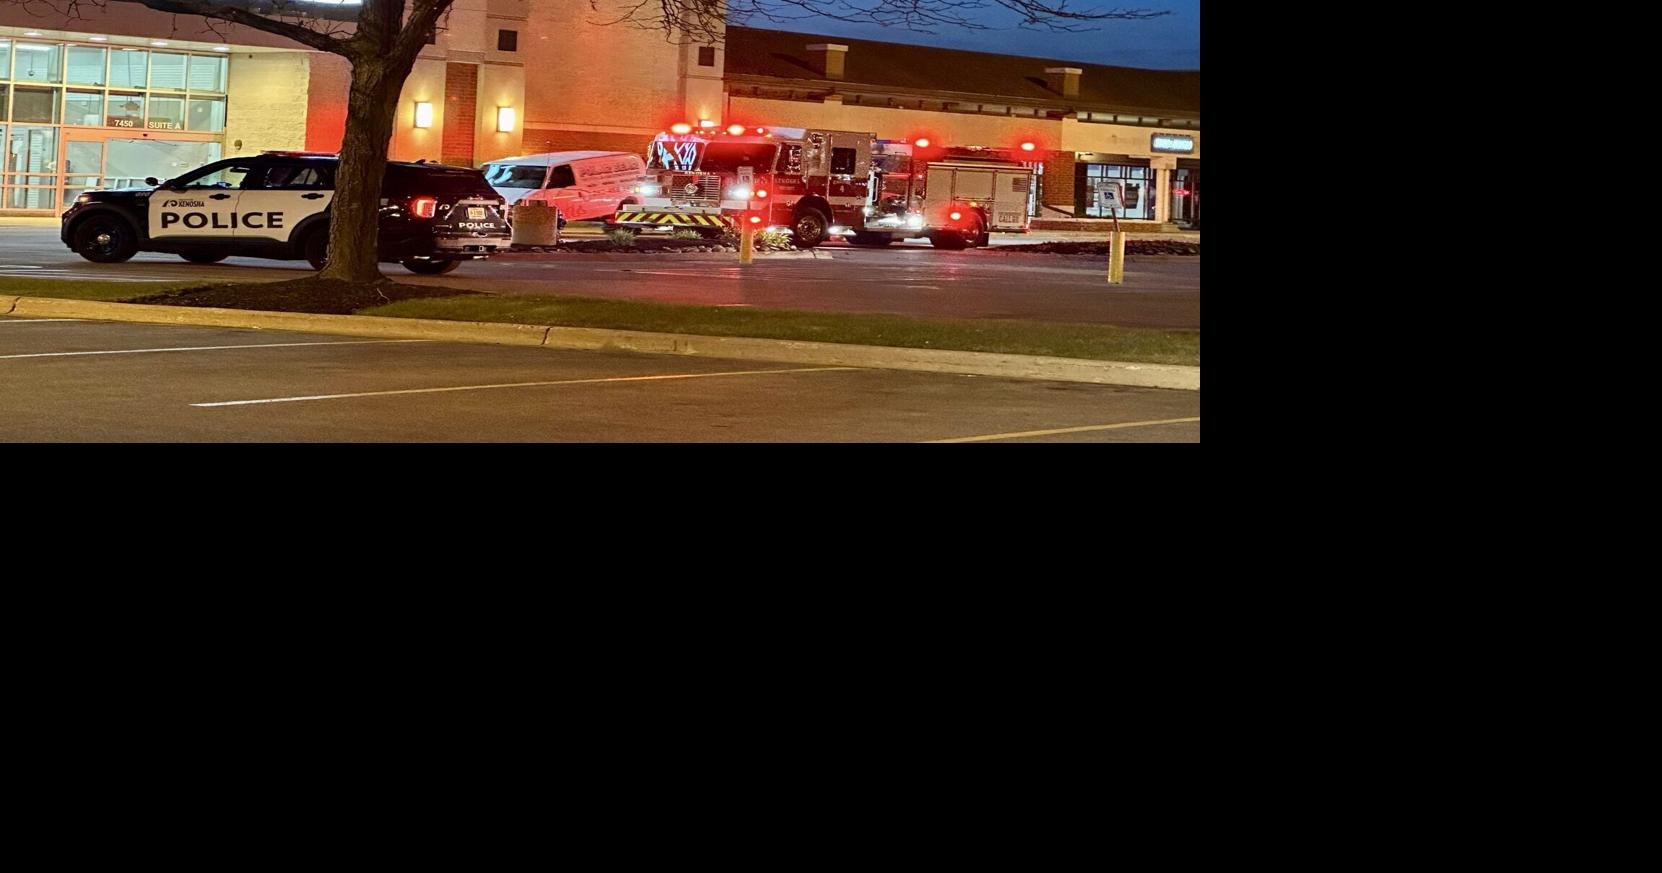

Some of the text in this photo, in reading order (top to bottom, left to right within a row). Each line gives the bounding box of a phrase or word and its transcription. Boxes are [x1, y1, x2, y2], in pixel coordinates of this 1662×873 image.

[114, 119, 134, 127] 7450
[148, 121, 182, 130] SUITE A
[161, 212, 283, 229] POLICE
